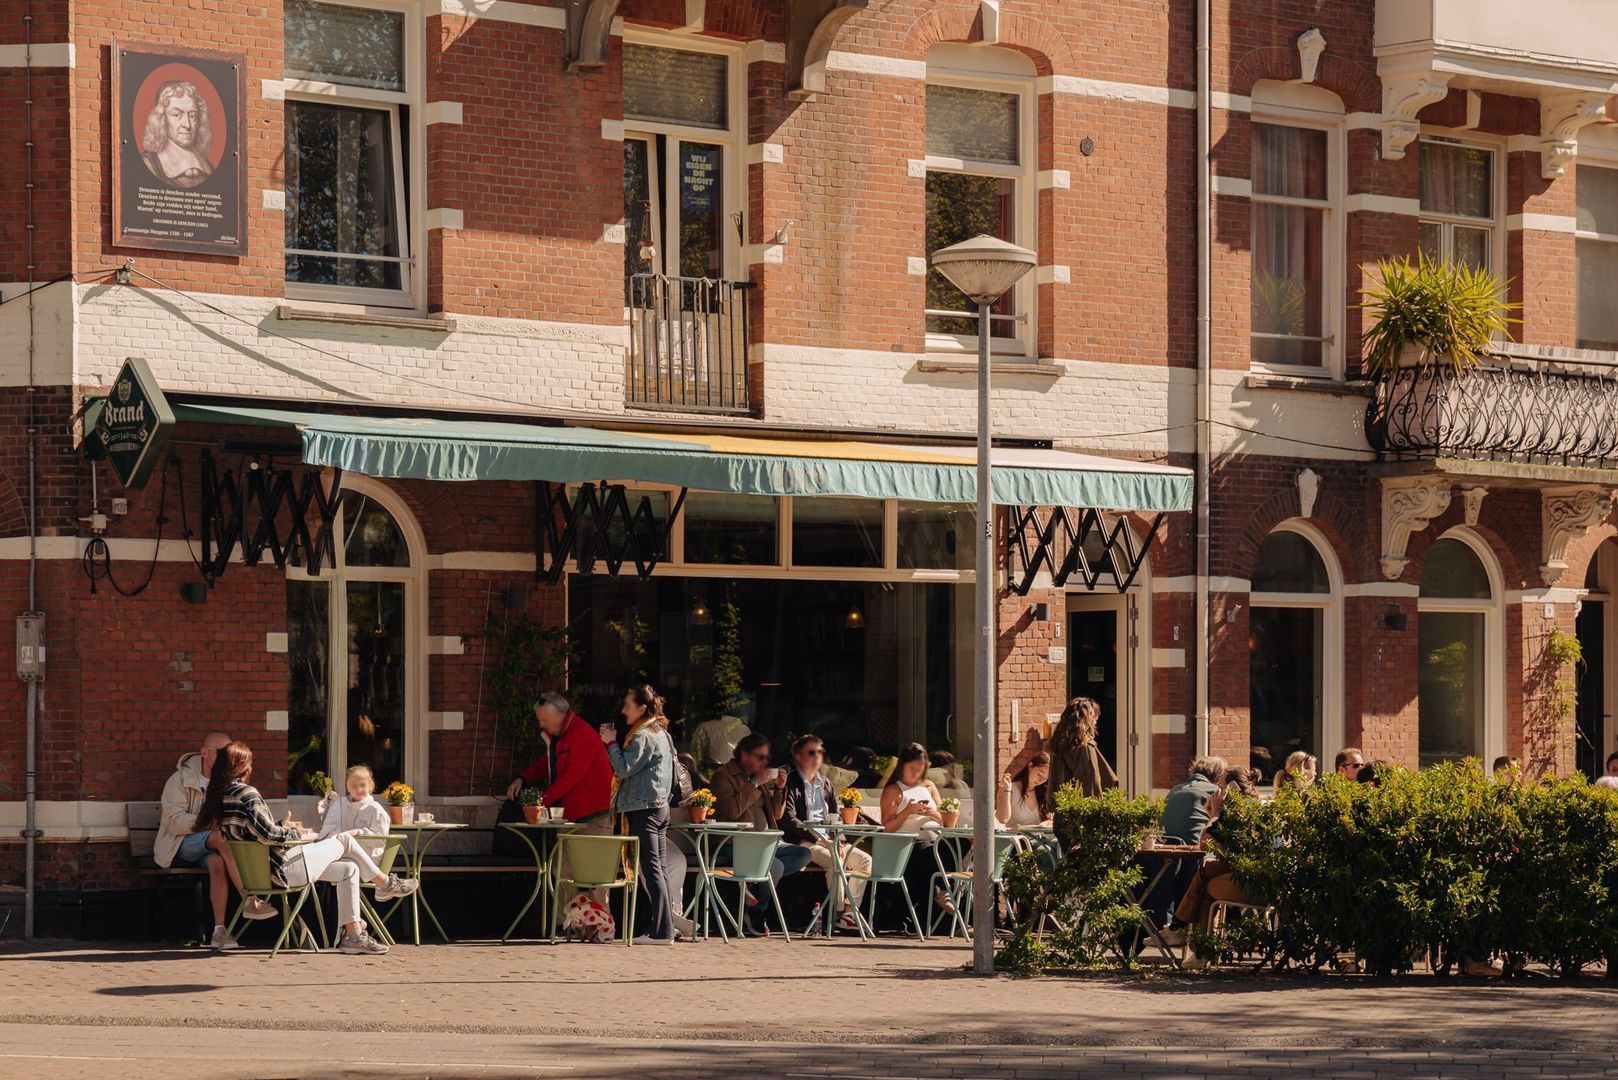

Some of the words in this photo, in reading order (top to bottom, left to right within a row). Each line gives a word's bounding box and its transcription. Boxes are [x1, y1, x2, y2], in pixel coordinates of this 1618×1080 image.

[691, 154, 706, 162] WIJ
[684, 176, 714, 185] NACHT
[105, 400, 144, 426] Brand
